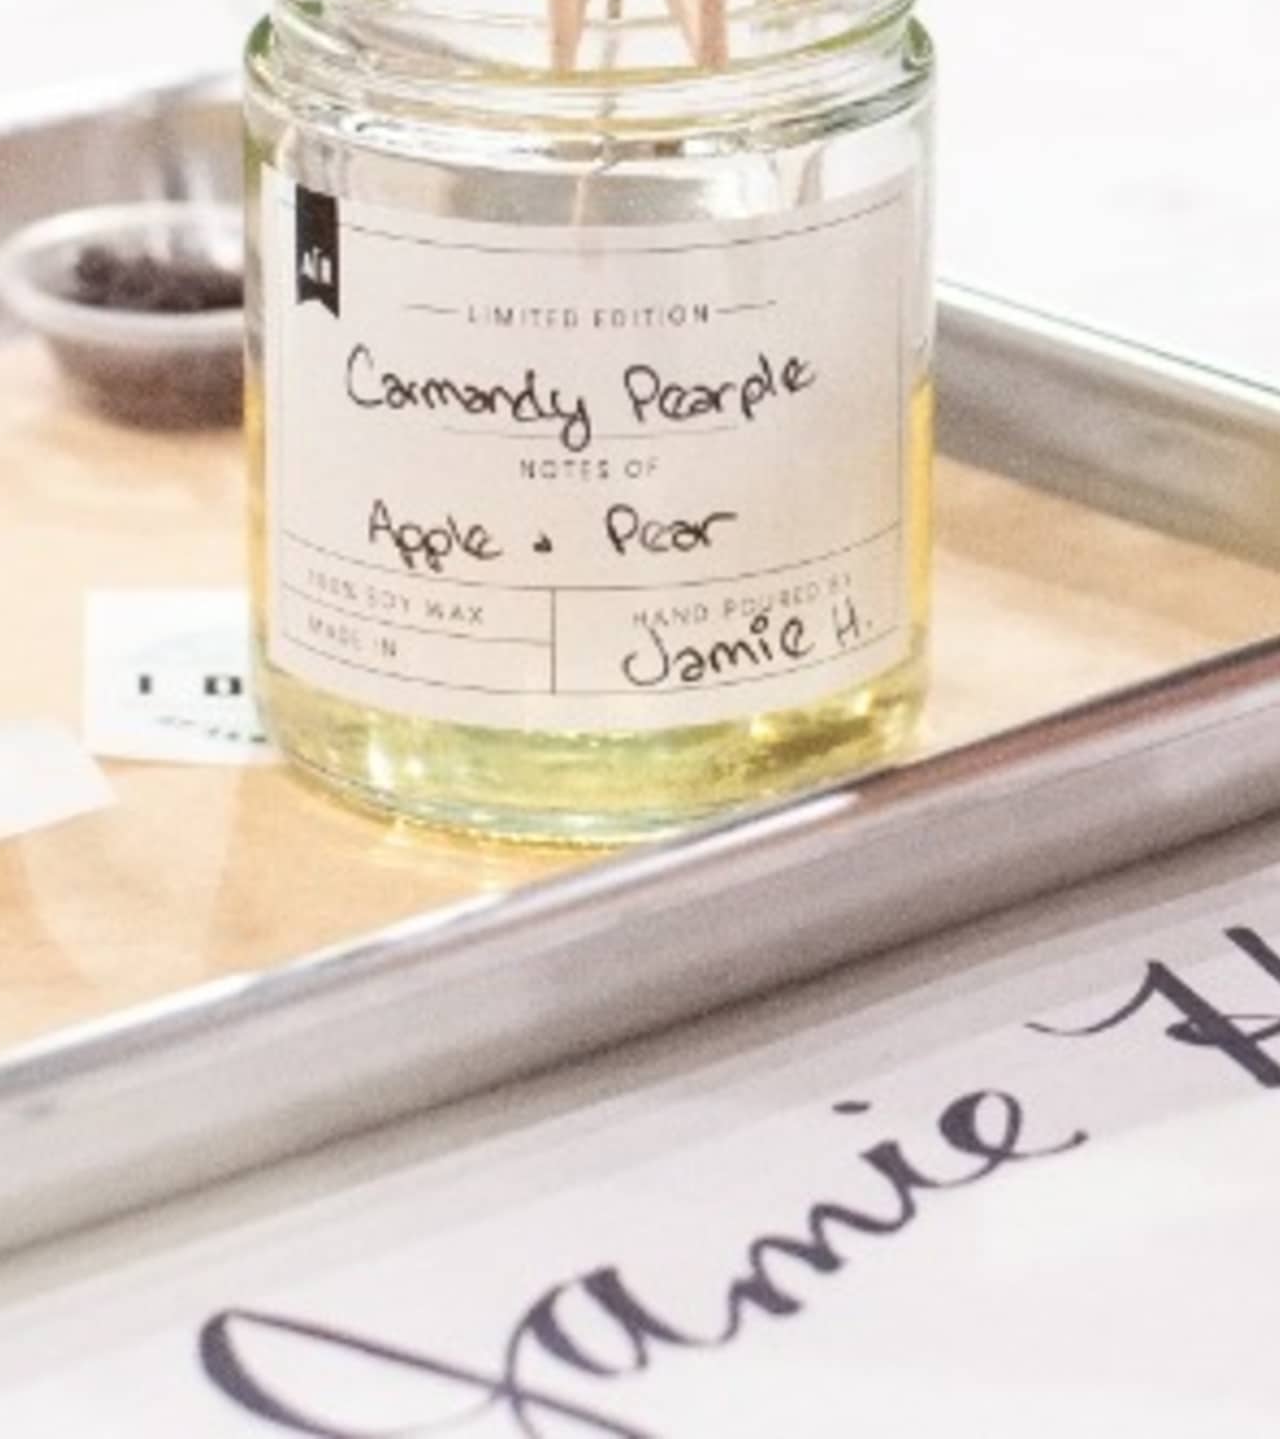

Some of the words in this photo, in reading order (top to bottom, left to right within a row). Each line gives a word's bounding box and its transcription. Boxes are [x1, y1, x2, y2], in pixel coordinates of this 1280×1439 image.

[467, 303, 579, 329] LIMITED
[592, 302, 710, 329] EDITION
[623, 353, 818, 424] Pearple
[519, 458, 609, 481] NOTES
[624, 457, 661, 480] OF
[368, 498, 504, 574] Apple
[604, 502, 738, 556] Pear
[424, 596, 485, 627] WAX
[631, 601, 711, 630] HAND
[621, 613, 818, 687] Jamie
[195, 1087, 1090, 1439] Jamie
